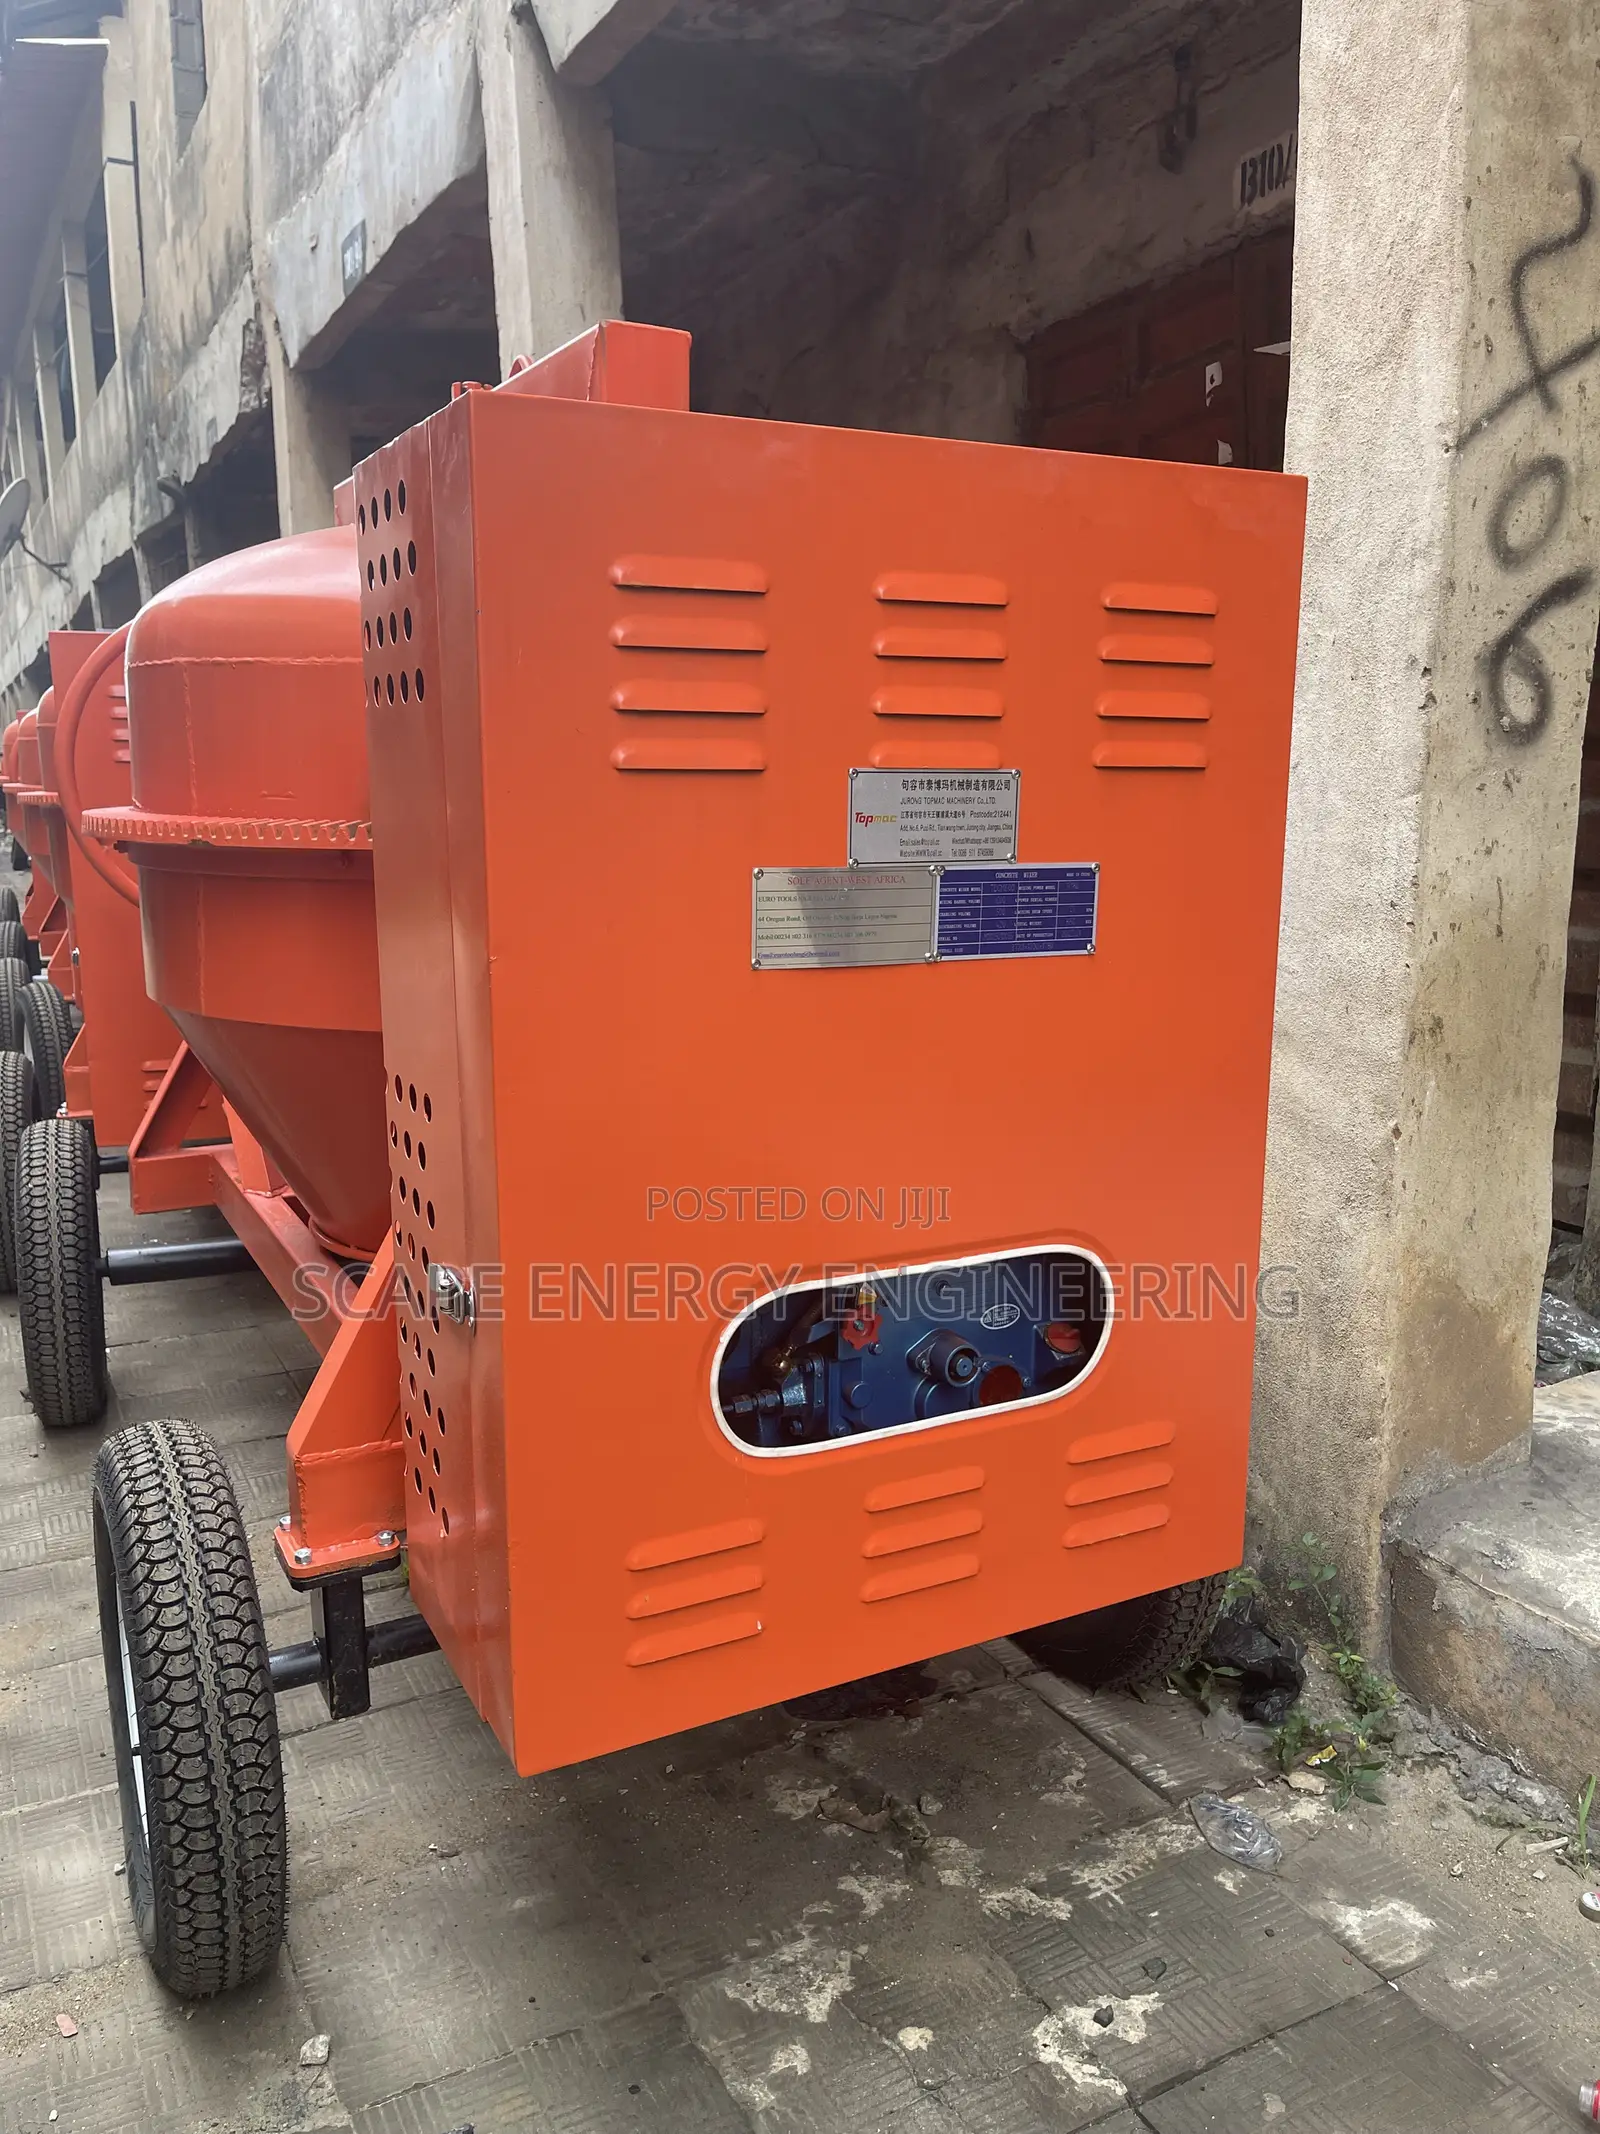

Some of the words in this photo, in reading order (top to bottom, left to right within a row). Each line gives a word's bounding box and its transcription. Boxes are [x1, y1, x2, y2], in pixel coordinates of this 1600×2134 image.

[900, 797, 922, 805] JURONG
[924, 797, 945, 805] TOPMAC
[947, 796, 975, 805] MACHINERY
[855, 812, 897, 827] Topmac
[787, 877, 810, 886] SOLE
[814, 875, 871, 885] AGENT-WEST
[874, 875, 906, 884] AFRICA
[758, 895, 776, 903] EURO
